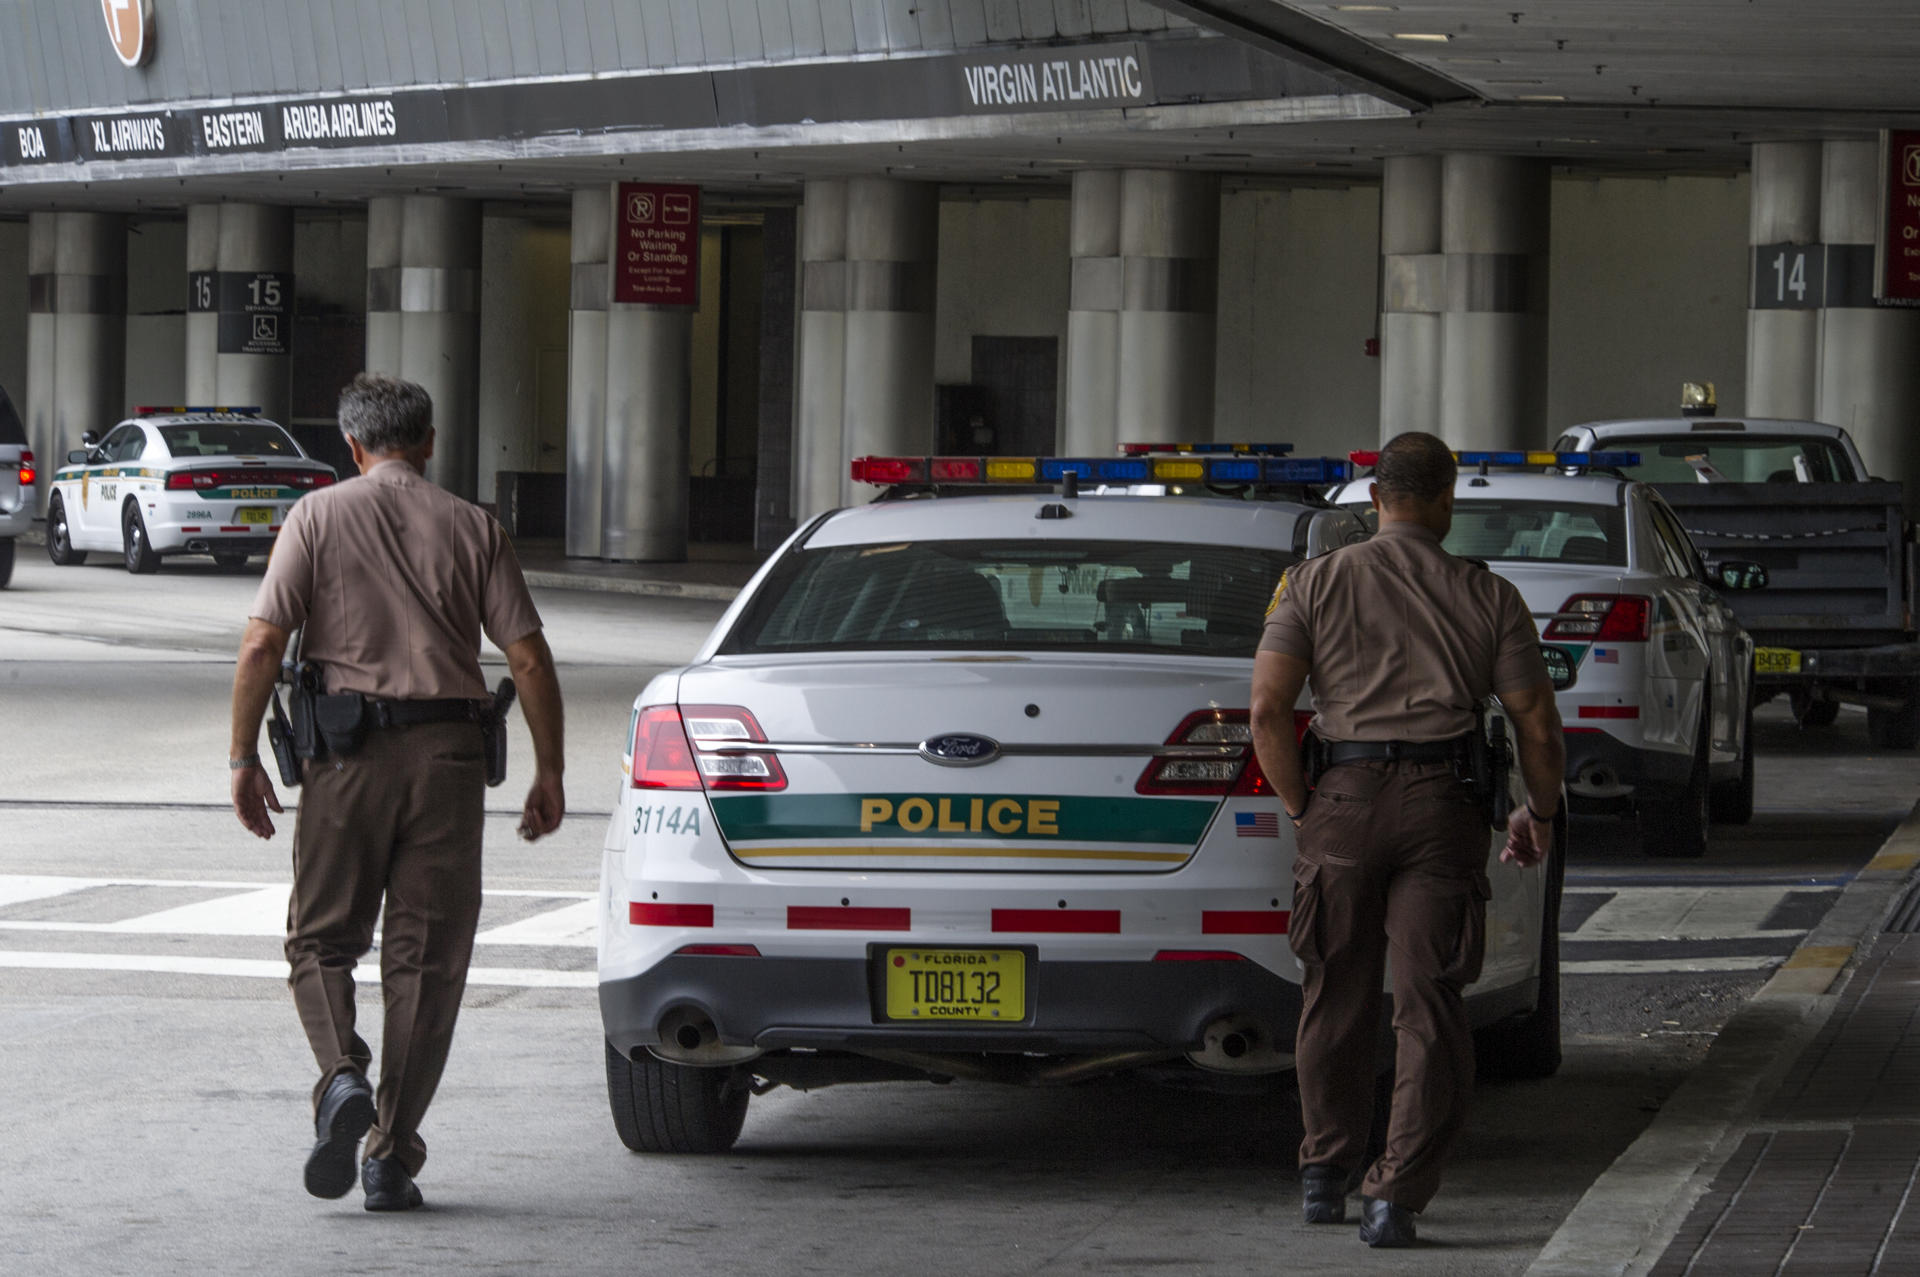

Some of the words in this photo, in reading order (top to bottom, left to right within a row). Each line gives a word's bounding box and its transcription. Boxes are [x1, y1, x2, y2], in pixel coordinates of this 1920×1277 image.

[964, 63, 1038, 106] VIRGIN
[1042, 55, 1143, 103] ATLANTIC
[202, 111, 265, 148] EASTERN
[282, 104, 331, 140] ARUBA
[330, 100, 397, 138] AIRLINES
[18, 126, 47, 158] BOA
[91, 121, 111, 152] XL
[111, 117, 166, 152] AIRWAYS
[630, 228, 645, 238] No
[647, 228, 686, 242] Parking
[639, 240, 677, 253] Waiting
[1903, 225, 1919, 240] Or
[627, 250, 640, 262] Or
[642, 251, 688, 265] Standing
[1772, 252, 1807, 302] 14
[195, 274, 211, 309] 15
[247, 279, 281, 305] 15
[101, 483, 117, 501] POLICE
[231, 488, 279, 499] POLICE
[937, 737, 981, 757] Ford
[633, 805, 701, 836] 3114A
[859, 797, 1060, 835] POLICE
[924, 955, 988, 965] FLORIDA
[909, 970, 1001, 1004] TD8132
[930, 1006, 981, 1015] COUNTY
